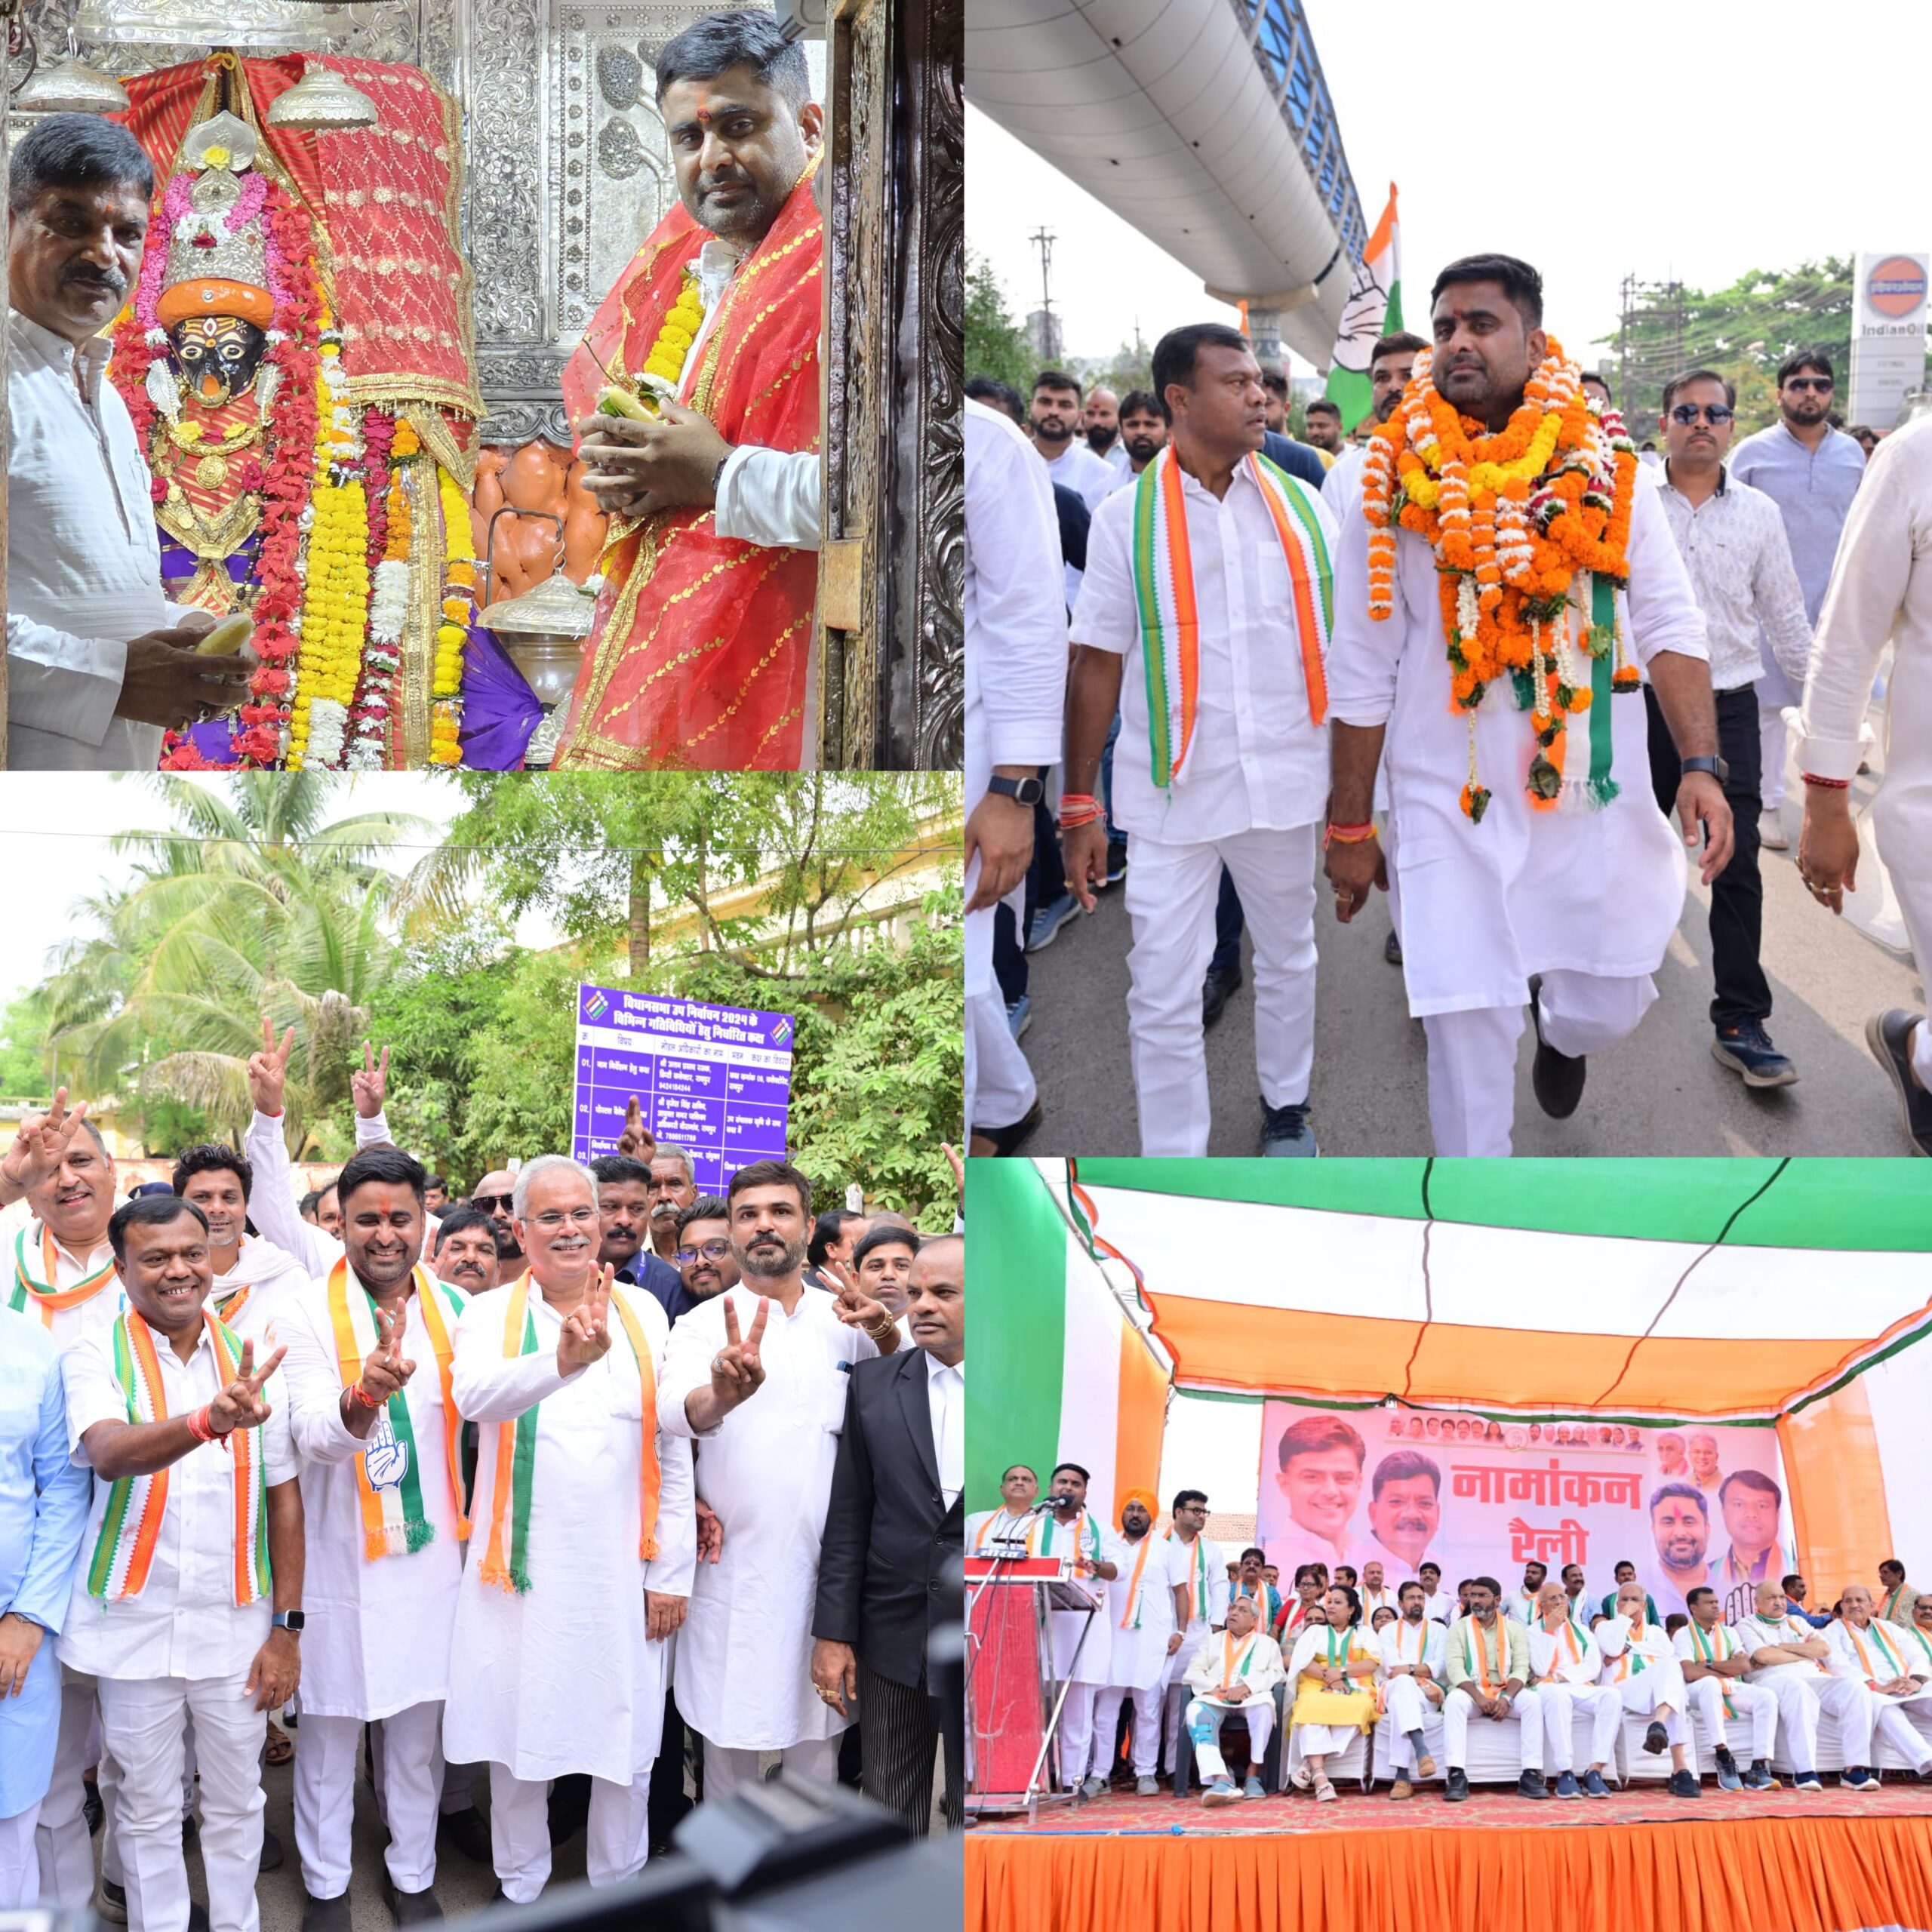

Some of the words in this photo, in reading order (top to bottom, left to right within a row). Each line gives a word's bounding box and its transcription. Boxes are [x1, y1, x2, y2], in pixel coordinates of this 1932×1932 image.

[1862, 323, 1924, 336] IndianOil
[623, 994, 670, 1014] विधानसभा
[672, 1004, 685, 1017] उप
[687, 1004, 720, 1022] निर्वाचन
[721, 1011, 747, 1026] 2024
[749, 1013, 758, 1026] के
[614, 1010, 647, 1028] विभिन्न
[648, 1017, 697, 1035] गतिविधियों
[698, 1021, 711, 1041] हेतु
[712, 1025, 746, 1042] निर्धारित
[747, 1032, 765, 1044] कक्ष
[617, 1033, 632, 1046] विषय
[678, 1041, 701, 1054] अधिकारी
[703, 1048, 711, 1056] का
[713, 1049, 724, 1057] नाम
[751, 1054, 762, 1063] कक्ष
[764, 1055, 771, 1063] का
[773, 1054, 790, 1066] विवरण
[1451, 1458, 1643, 1510] नामांकन
[1508, 1516, 1589, 1565] रैली
